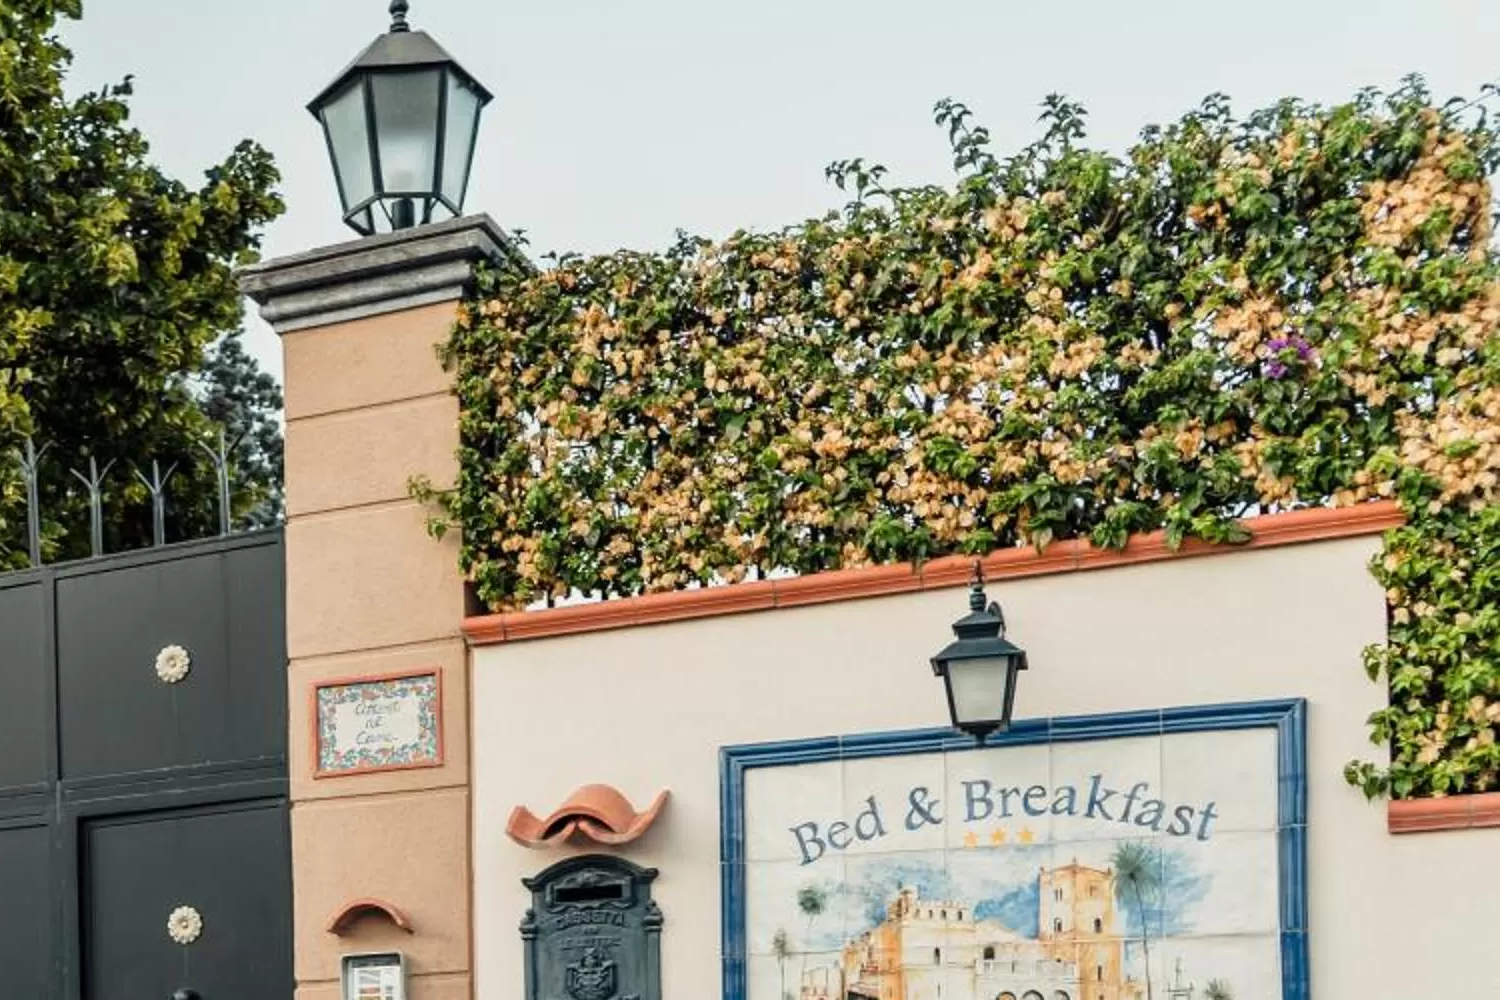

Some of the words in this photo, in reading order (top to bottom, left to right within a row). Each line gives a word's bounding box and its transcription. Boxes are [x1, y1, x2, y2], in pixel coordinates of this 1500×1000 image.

[788, 795, 888, 867] Bed
[904, 786, 944, 831] &
[961, 774, 1219, 842] Breakfast
